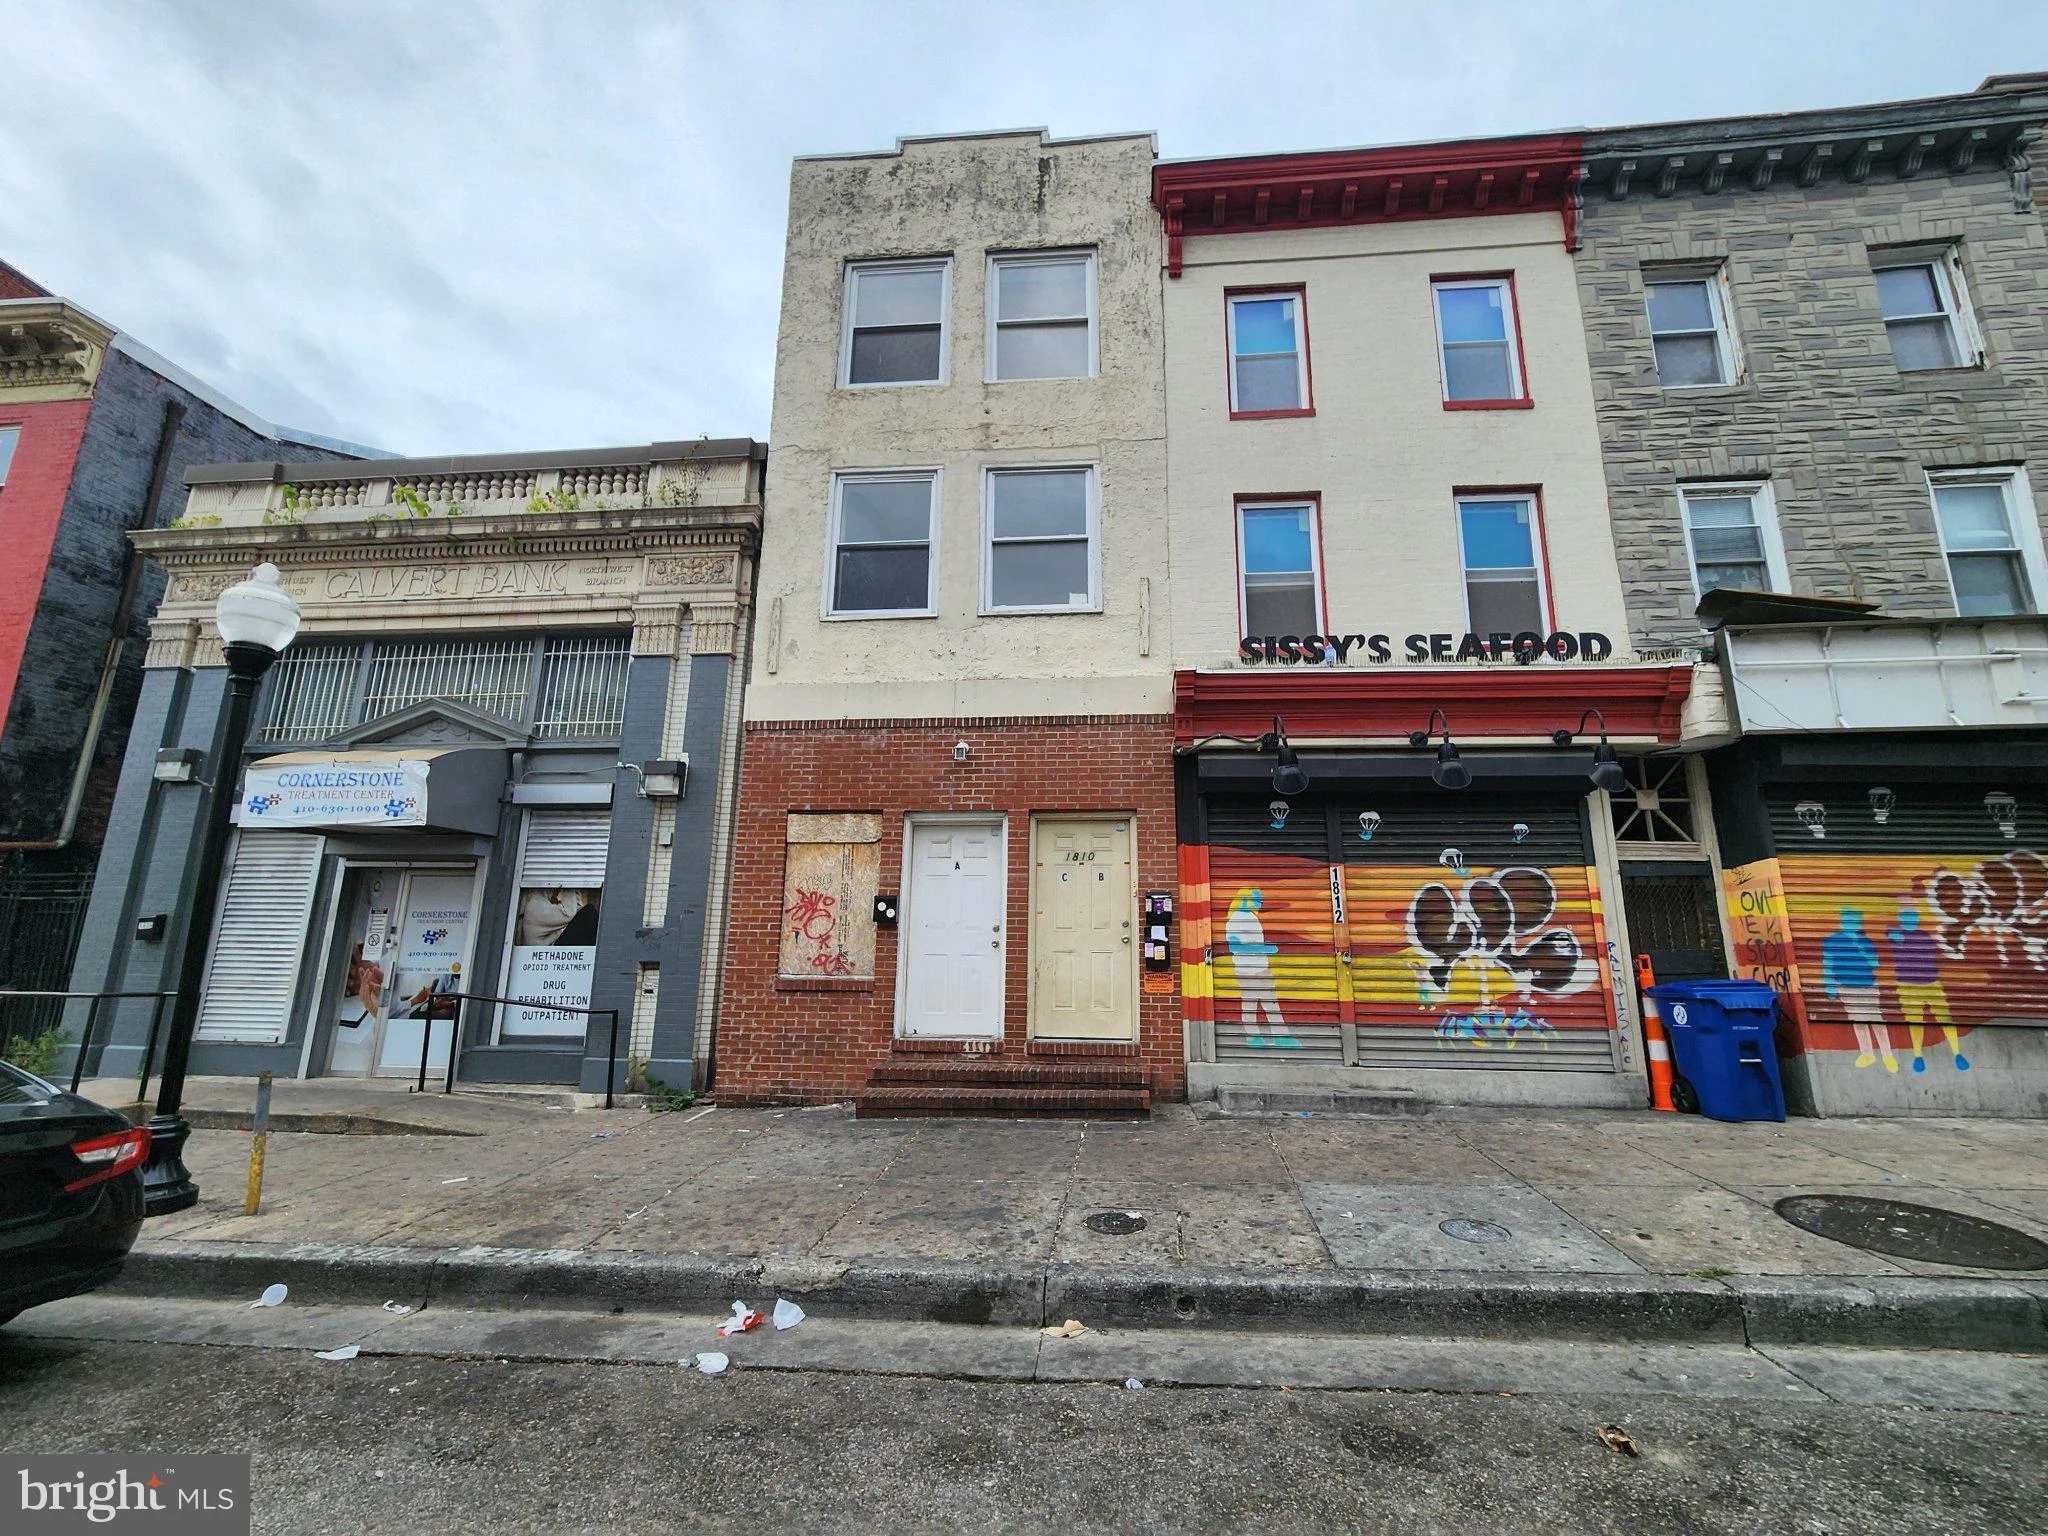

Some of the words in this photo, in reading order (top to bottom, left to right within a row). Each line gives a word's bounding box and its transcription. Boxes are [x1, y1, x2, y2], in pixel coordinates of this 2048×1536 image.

[610, 565, 634, 573] WEST
[324, 566, 470, 599] CALVERT
[476, 562, 567, 595] BANK
[585, 577, 626, 586] BRANCH
[1240, 634, 1392, 665] SISSY'S
[1405, 631, 1612, 663] SEAFOOD
[277, 772, 404, 788] CORNERSTONE
[288, 790, 351, 800] TREATMENT
[353, 790, 394, 800] CENTER
[293, 804, 380, 814] 410-630-1090
[1065, 852, 1095, 862] 1810
[954, 862, 961, 870] A
[1061, 873, 1068, 882] C
[1098, 873, 1104, 882] B
[1332, 867, 1343, 924] 1812
[411, 910, 469, 919] CORNERSTONE
[532, 951, 584, 961] METHADONE
[522, 963, 549, 971] OPIOID
[553, 963, 592, 971] TREATMENT
[543, 980, 567, 990] DRUG
[521, 1011, 580, 1021] OUTPATIENT
